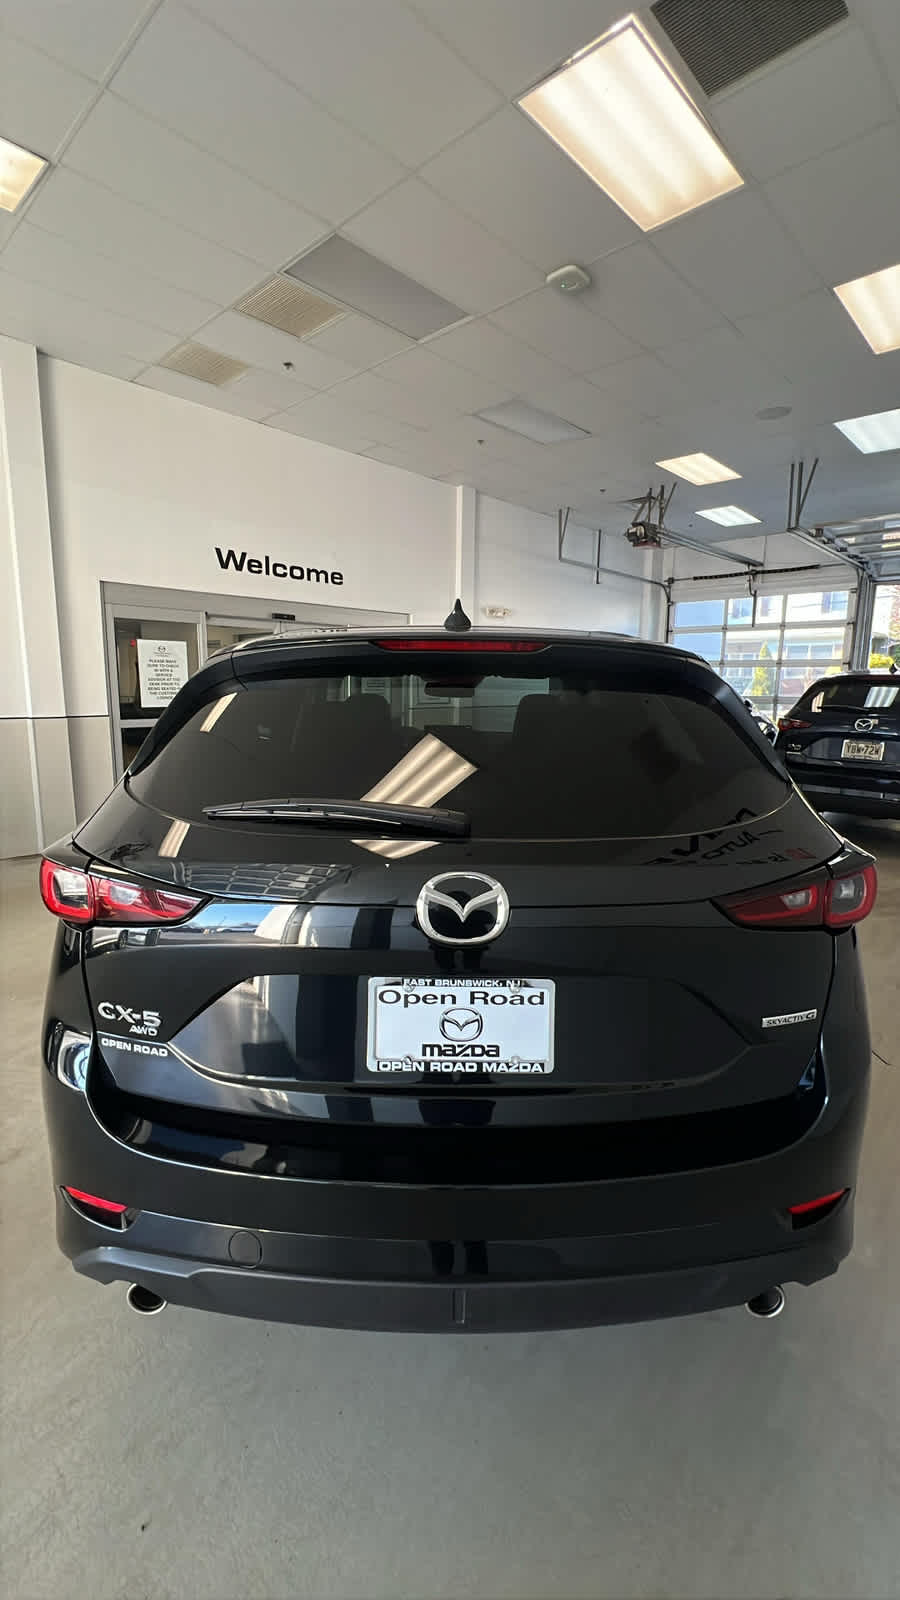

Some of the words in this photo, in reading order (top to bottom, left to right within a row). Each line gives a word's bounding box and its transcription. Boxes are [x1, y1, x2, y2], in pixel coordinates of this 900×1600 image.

[214, 546, 343, 585] Welcome
[506, 979, 521, 987] NJ
[378, 989, 457, 1008] Open
[469, 991, 545, 1006] Road
[98, 1001, 162, 1027] CX-5
[128, 1025, 158, 1036] AWD
[101, 1038, 132, 1052] OPEN
[133, 1044, 168, 1057] ROAD
[421, 1043, 500, 1058] mazda
[378, 1061, 425, 1072] OPEN
[429, 1062, 478, 1072] ROAD
[482, 1062, 543, 1073] MAZDA
